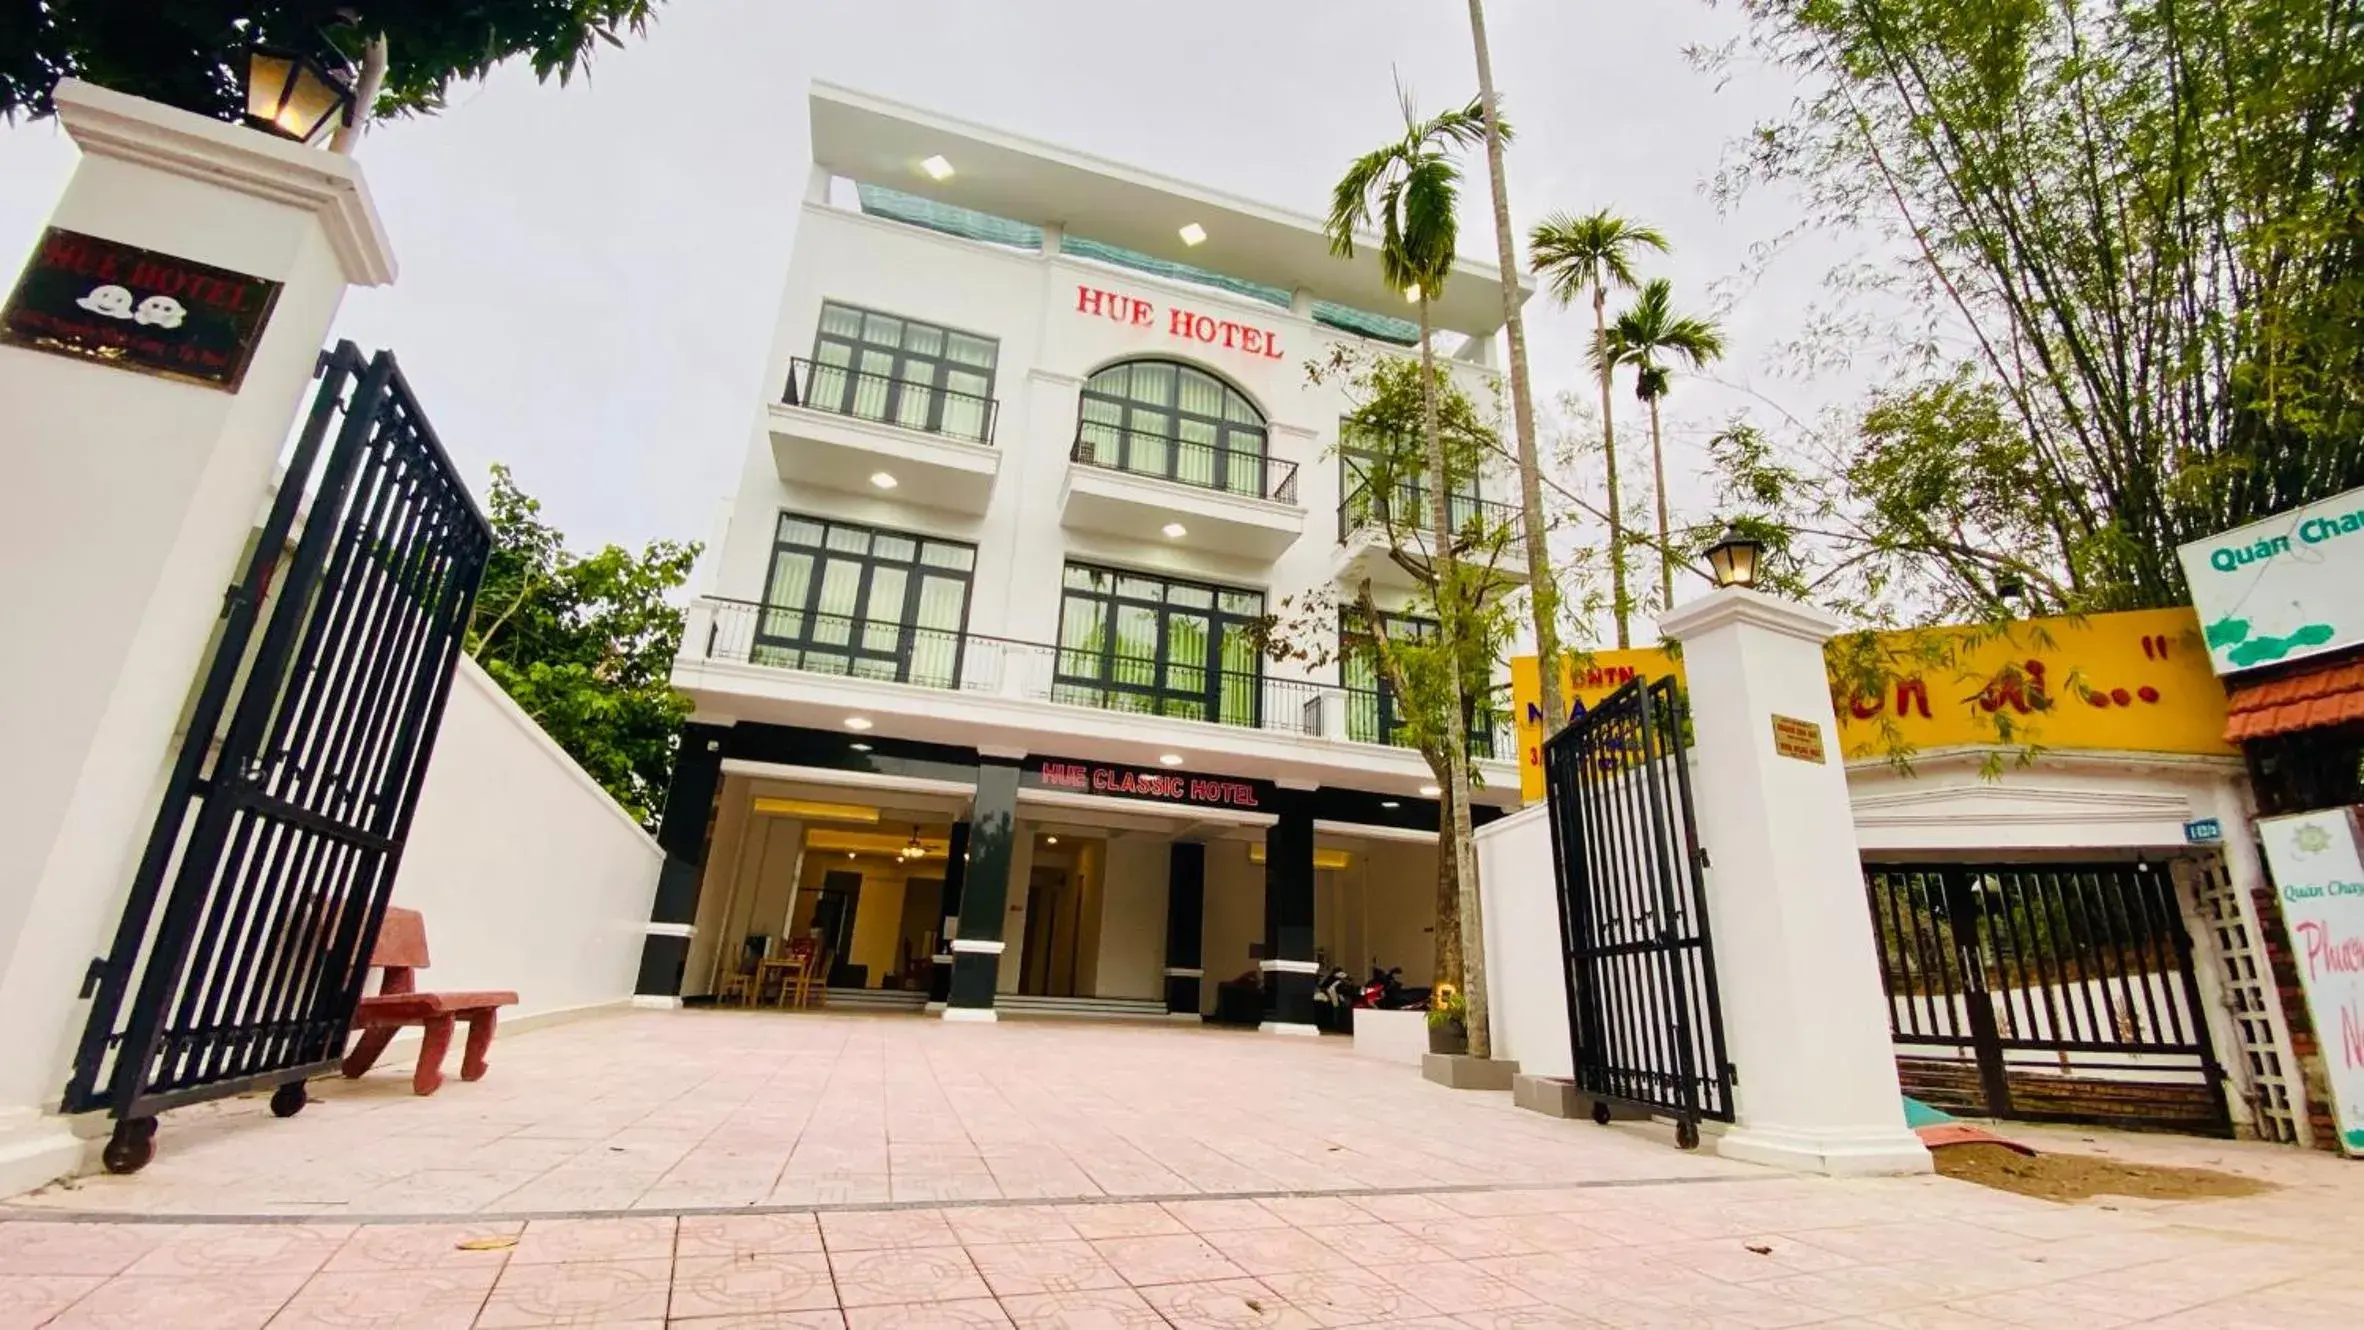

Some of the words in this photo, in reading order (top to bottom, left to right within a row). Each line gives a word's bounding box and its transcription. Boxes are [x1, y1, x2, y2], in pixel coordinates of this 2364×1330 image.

[130, 261, 248, 309] HOTEL
[1077, 286, 1154, 327] HUE
[1169, 307, 1284, 359] HOTEL
[1042, 763, 1087, 787] HUE
[1093, 769, 1184, 798] CLASSIC
[1191, 780, 1258, 805] HOTEL
